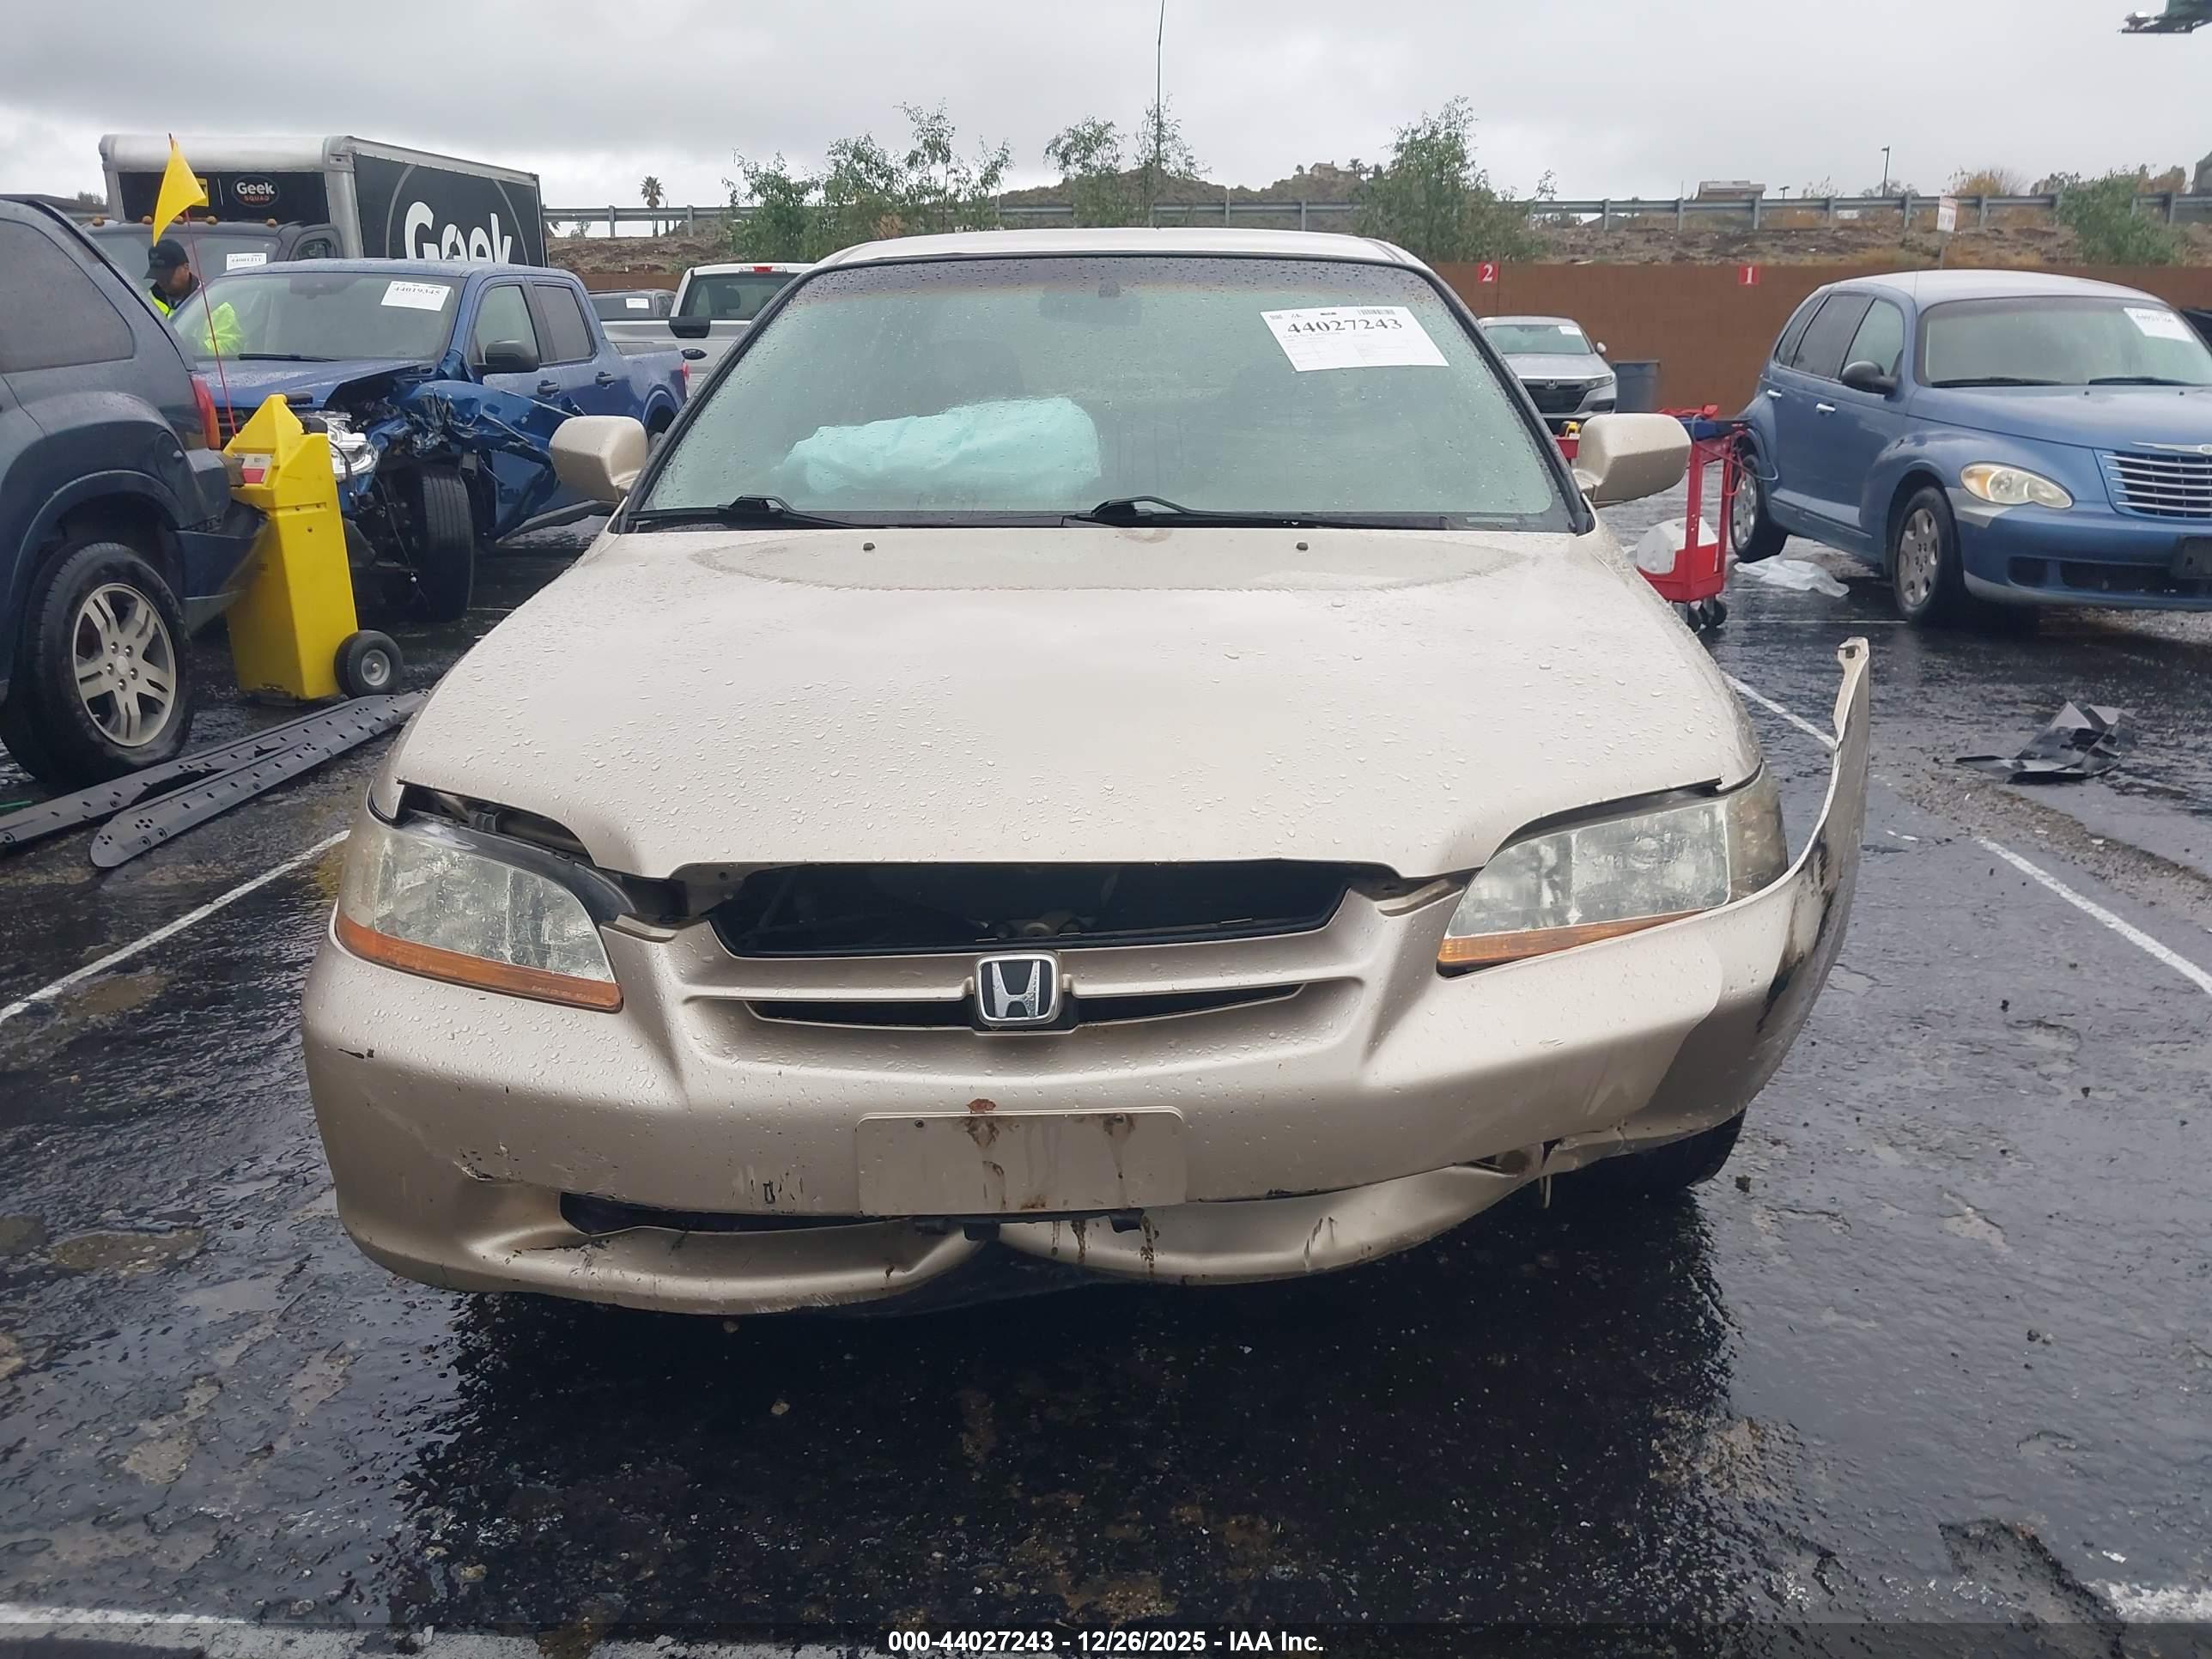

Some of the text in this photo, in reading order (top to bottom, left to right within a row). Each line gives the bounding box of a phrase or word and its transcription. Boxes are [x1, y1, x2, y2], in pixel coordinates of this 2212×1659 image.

[236, 181, 275, 194] Geek
[1482, 264, 1493, 283] 2
[1745, 266, 1753, 284] 1
[1287, 318, 1402, 334] 44027243
